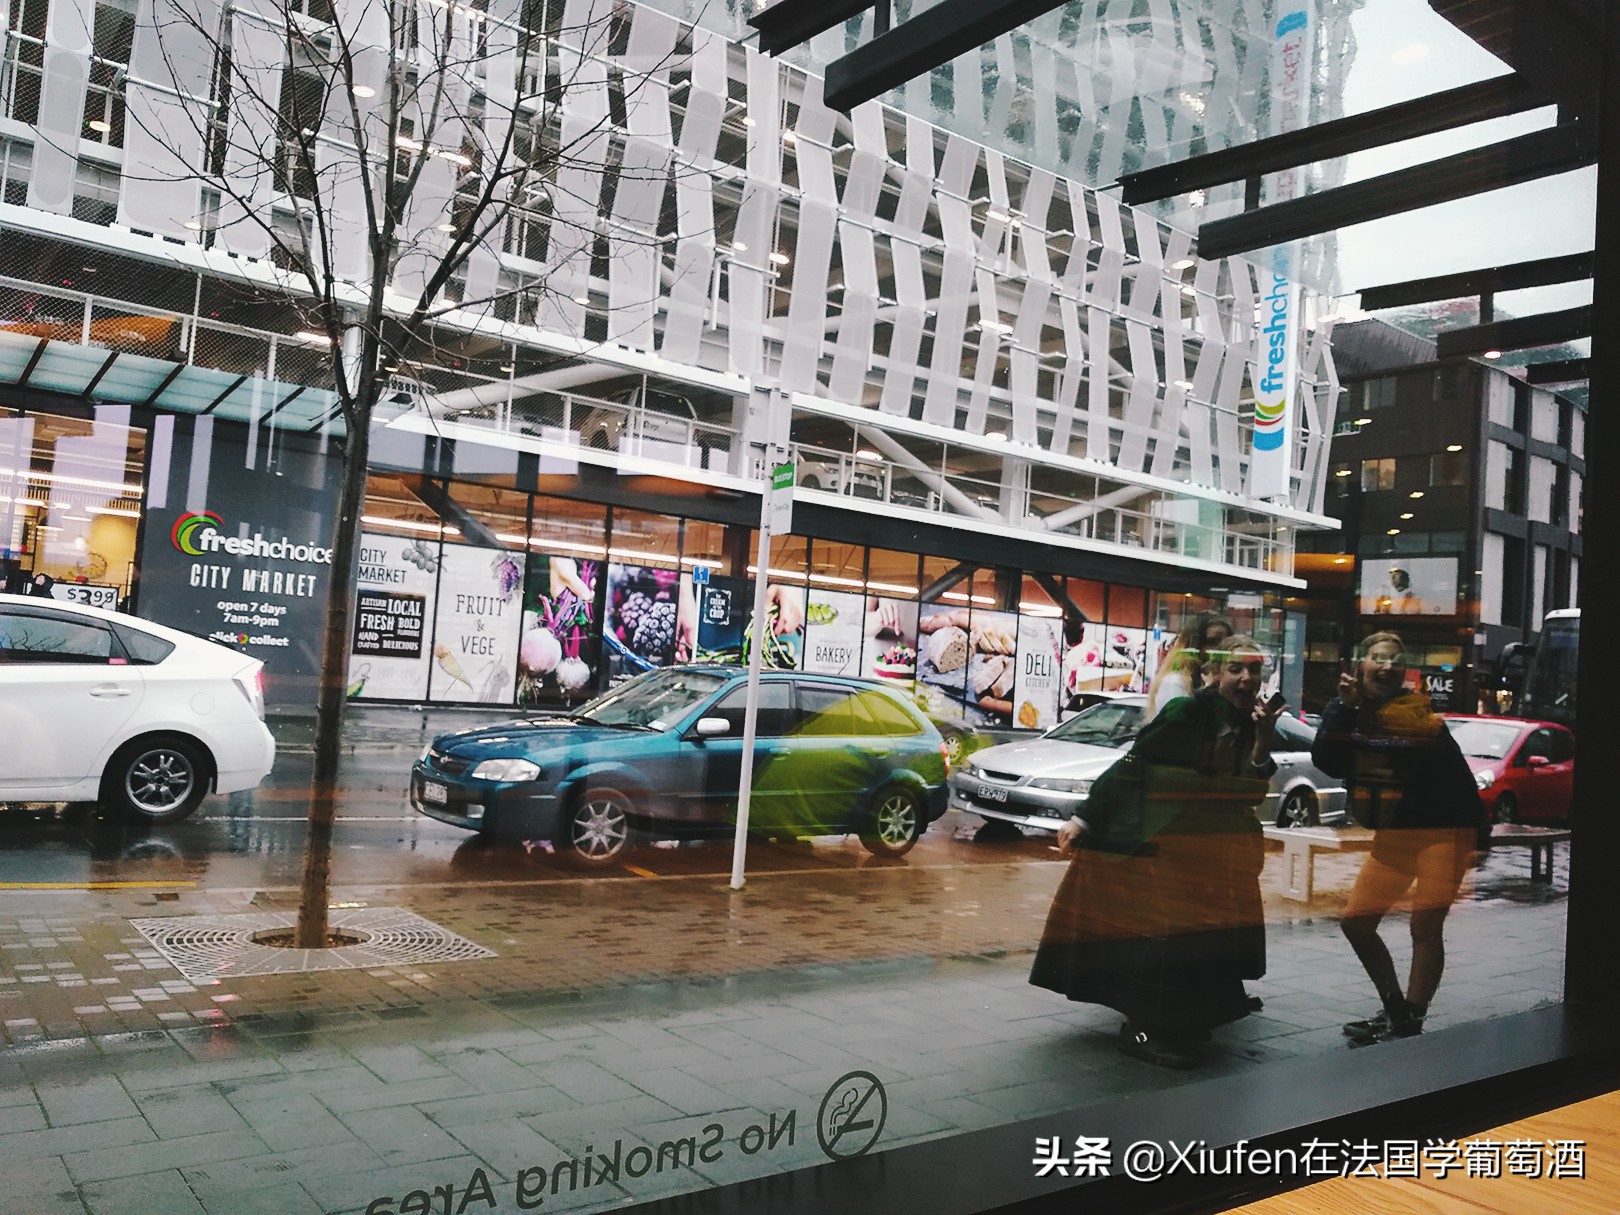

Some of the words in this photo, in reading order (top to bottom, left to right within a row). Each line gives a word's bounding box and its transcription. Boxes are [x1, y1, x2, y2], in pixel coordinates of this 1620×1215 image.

[360, 548, 387, 563] CITY
[189, 563, 231, 590] CITY
[242, 569, 317, 597] MARKET
[358, 566, 407, 583] MARKET
[216, 601, 248, 612] open
[250, 602, 259, 612] 7
[259, 603, 288, 616] days
[387, 599, 421, 616] LOCAL
[455, 594, 506, 616] FRUIT
[223, 613, 280, 627] 7am-9pm
[360, 613, 395, 630] FRESH
[398, 617, 421, 629] BOLD
[477, 619, 485, 632] &
[249, 634, 289, 646] collect
[461, 635, 496, 655] VEGE
[815, 646, 852, 663] BAKERY
[1025, 653, 1051, 677] DELI
[1425, 675, 1454, 692] SALE
